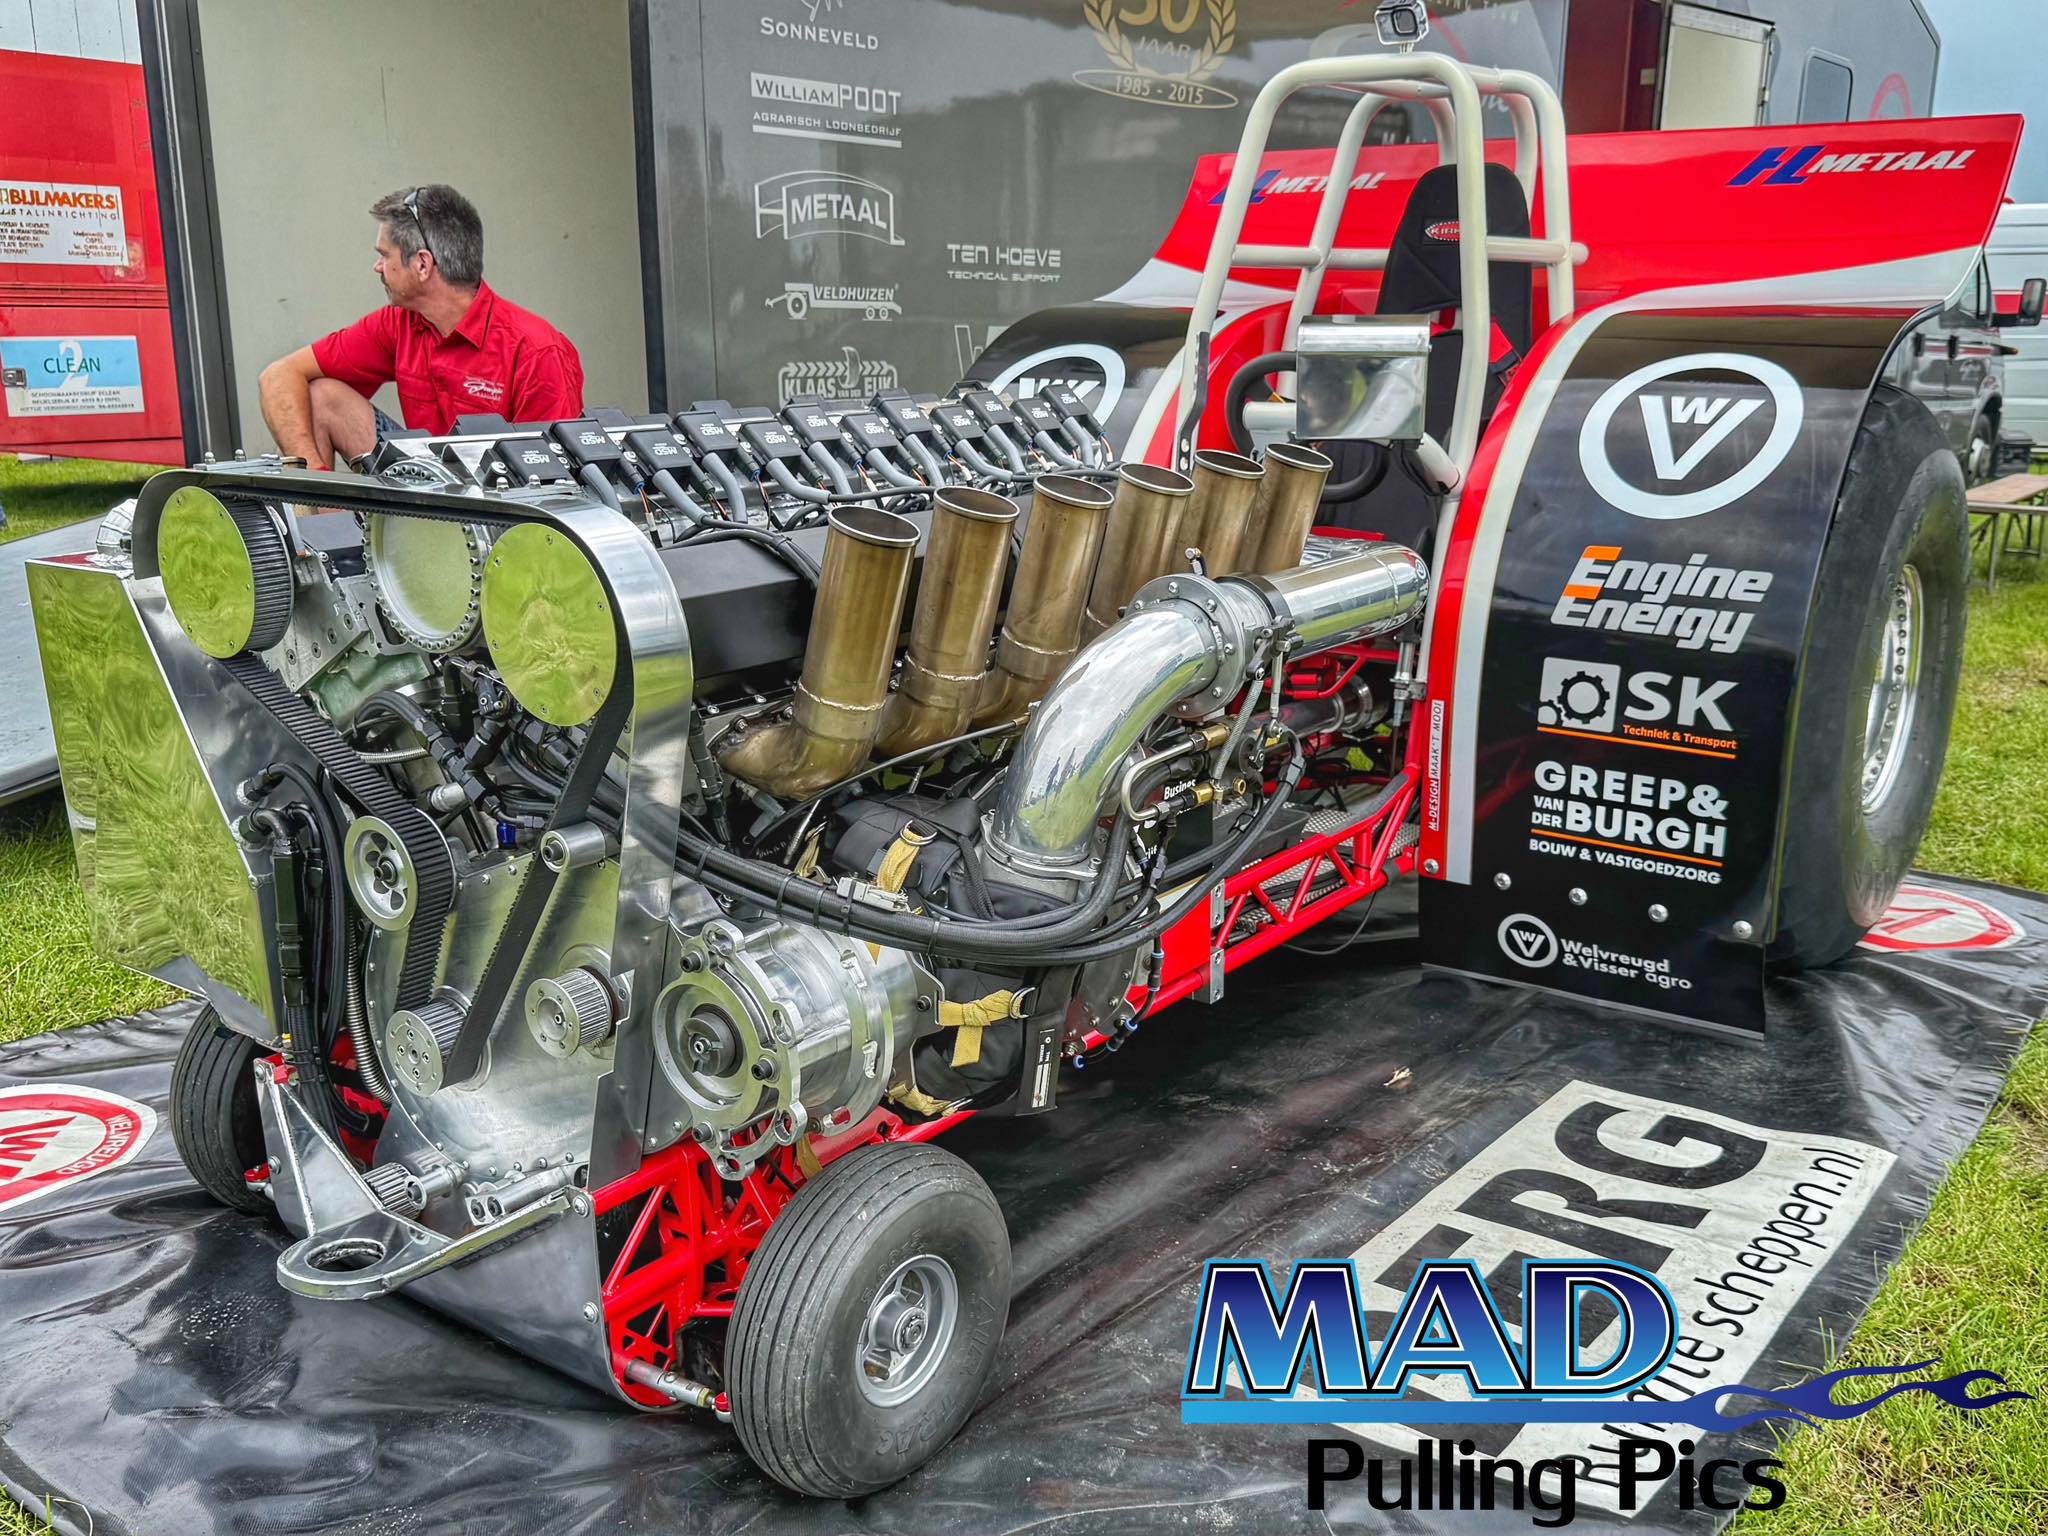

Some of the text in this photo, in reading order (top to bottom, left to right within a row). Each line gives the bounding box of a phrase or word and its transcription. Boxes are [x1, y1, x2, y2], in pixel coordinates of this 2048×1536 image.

[760, 16, 879, 50] SONNEVELD
[1135, 35, 1192, 59] JAAR
[755, 79, 901, 116] WILLIAM POOT
[1115, 75, 1151, 97] 1985
[1168, 83, 1204, 105] 2015
[753, 111, 902, 137] AGRARISCH LOONBEDRIJF
[1806, 149, 1976, 174] METAAL
[791, 193, 888, 230] METAAL
[947, 243, 1062, 268] TEN HOEVE
[947, 270, 1061, 283] TECHNICAL SUPPORT
[814, 285, 895, 301] VELDHUIZEN
[43, 357, 102, 374] CLEAN
[784, 376, 837, 400] KLAAS
[1565, 545, 1774, 605] Engine
[1550, 584, 1756, 655] Energy
[1623, 670, 1740, 732] SK
[1623, 724, 1738, 750] Techniek & Transport
[1533, 794, 1564, 812] VAN
[1531, 811, 1562, 829] DER
[1565, 800, 1728, 858] BURGH
[1529, 838, 1722, 885] BOUW & VASTGOEDZORG
[1560, 938, 1671, 973] Welvreugd
[1645, 971, 1693, 990] agro
[1692, 1147, 1865, 1337] scheppen.nl
